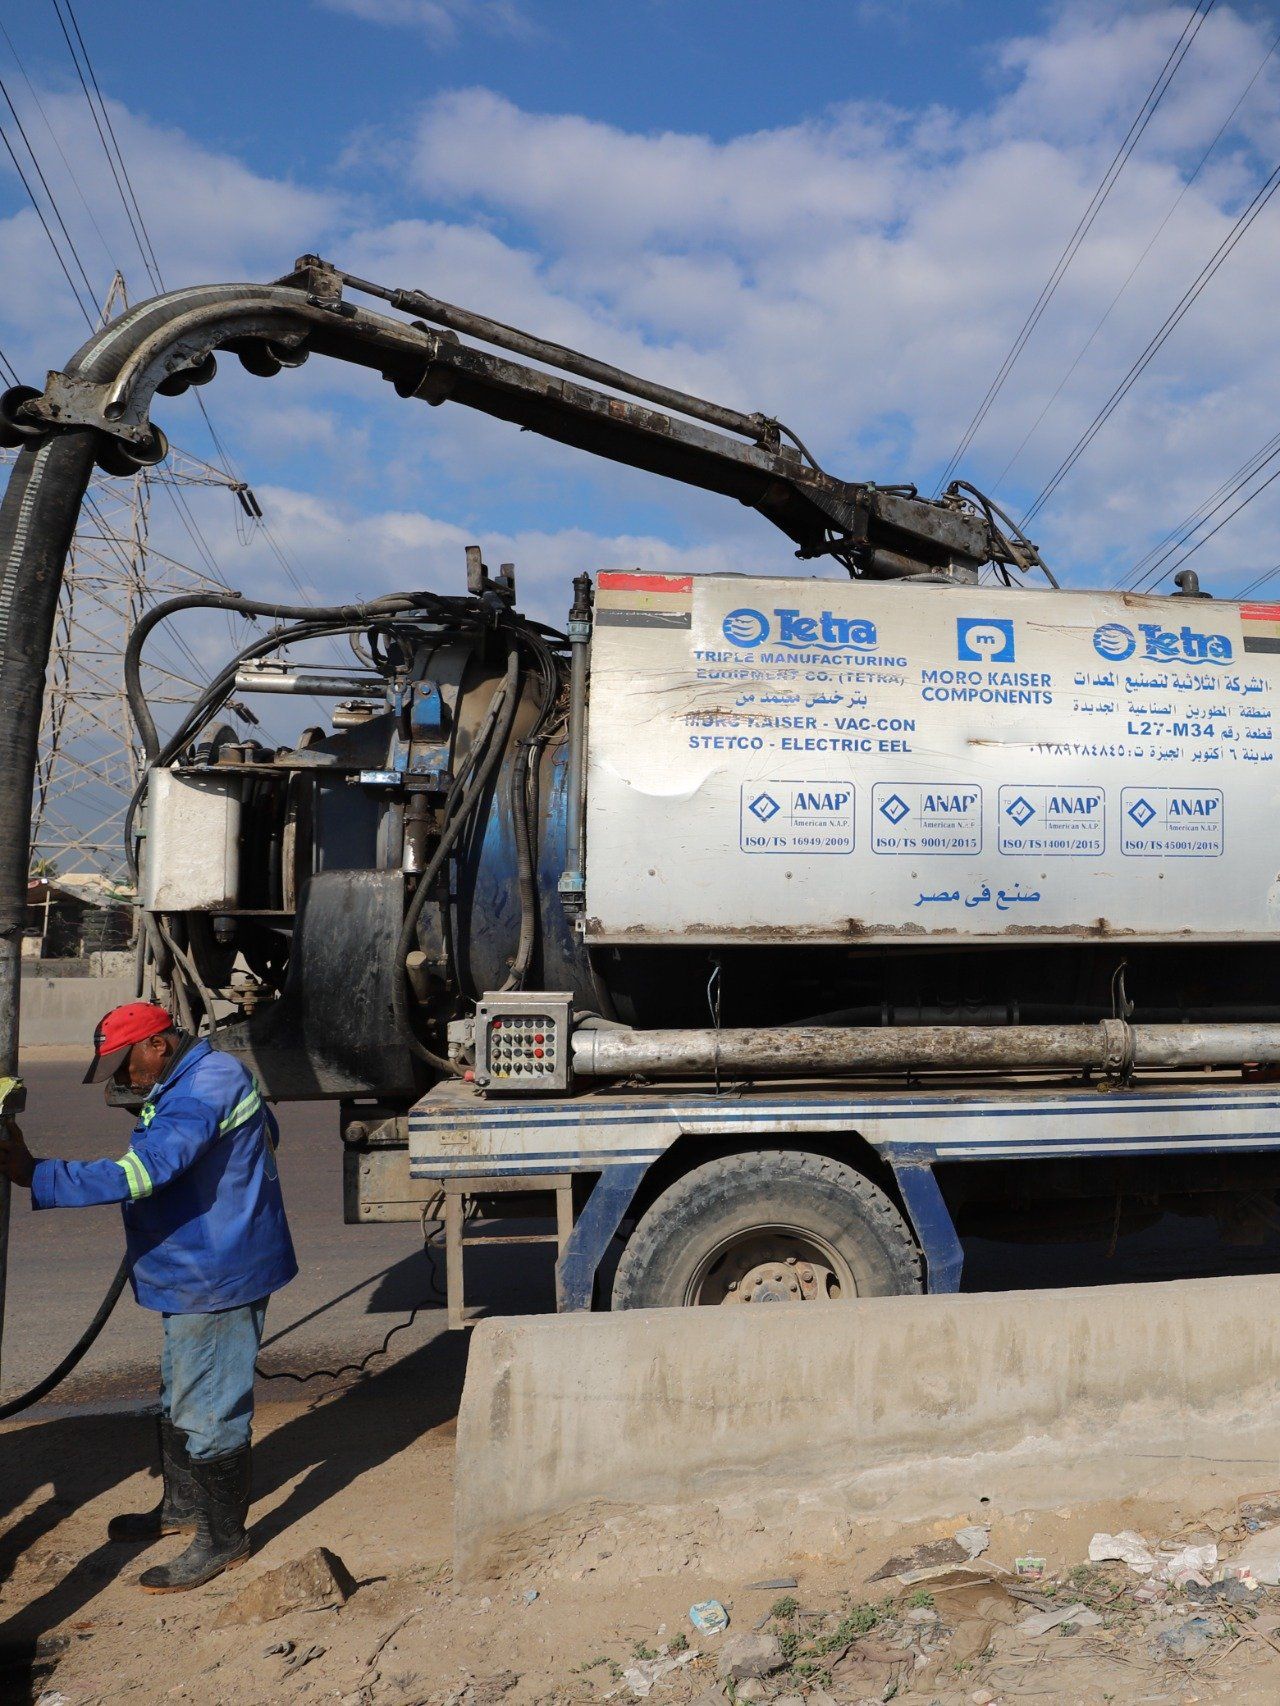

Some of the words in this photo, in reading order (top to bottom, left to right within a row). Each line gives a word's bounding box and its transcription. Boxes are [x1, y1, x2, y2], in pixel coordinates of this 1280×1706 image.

[773, 609, 878, 645] Tetra
[1138, 624, 1233, 659] Tetra
[694, 651, 755, 663] TRIPLE
[761, 652, 908, 667] MANUFACTURING
[805, 671, 833, 682] CO.
[839, 672, 905, 687] (TETRA)
[922, 670, 983, 686] MORO
[988, 672, 1051, 687] KAISER
[1074, 671, 1119, 687] المعدات
[1125, 672, 1168, 693] لتصنيع
[1172, 673, 1221, 693] الثلاثية
[922, 687, 1053, 704] COMPONENTS
[1073, 699, 1119, 716] الجديدة
[1128, 700, 1177, 717] الصناعية
[1186, 702, 1231, 719] المطورين
[1240, 704, 1271, 719] منطقة
[748, 716, 817, 730] KAISER
[834, 718, 916, 732] VAC-CON
[1127, 721, 1215, 738] L27-M34
[1221, 725, 1240, 741] رقم
[1246, 726, 1273, 740] قطعة
[689, 736, 763, 750] STETCO
[781, 737, 872, 752] ELECTRIC
[879, 740, 912, 753] EEL
[1150, 745, 1184, 762] الجيزة
[1191, 745, 1224, 763] أكتوبر
[1243, 747, 1273, 765] مدينة
[794, 792, 850, 811] ANAP
[924, 794, 978, 813] ANAP
[1048, 796, 1101, 814] ANAP
[1169, 798, 1219, 816] ANAP
[794, 820, 827, 828] American
[923, 821, 956, 829] American
[1048, 822, 1079, 830] American
[1169, 824, 1199, 832] American
[745, 836, 787, 847] ISO/TS
[792, 837, 850, 846] 16949/2009
[877, 837, 917, 848] ISO/TS
[921, 837, 977, 848] 9001/2015
[1003, 839, 1041, 849] ISO/TS
[1043, 839, 1100, 850] 14001/2015
[1125, 840, 1162, 850] ISO/TS
[1164, 841, 1219, 850] 45001/2018
[913, 888, 960, 907] مصر
[995, 882, 1042, 911] صنع
